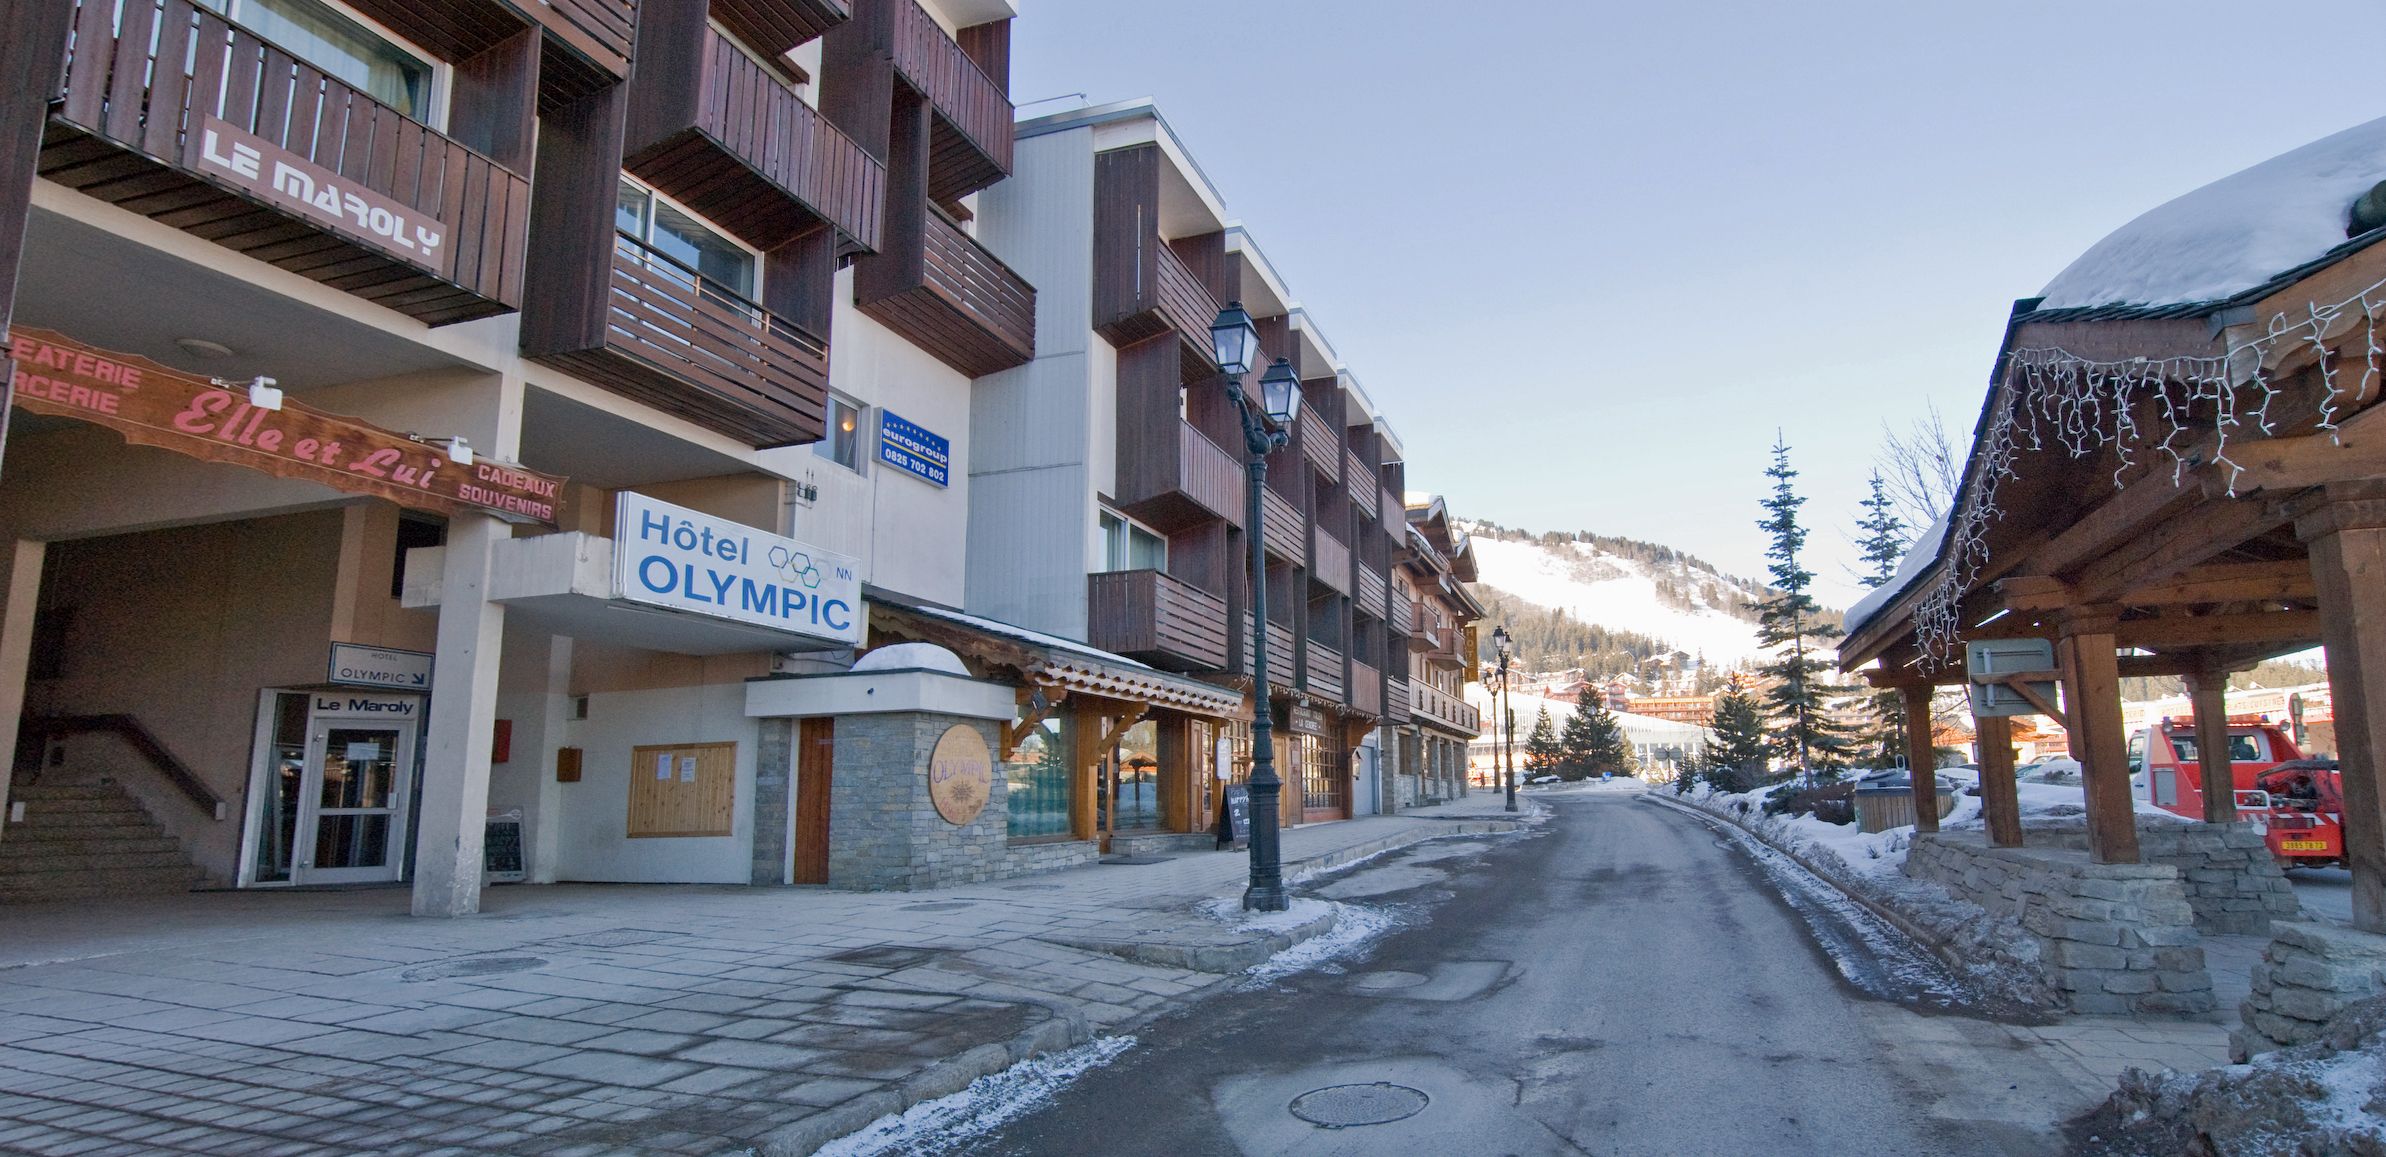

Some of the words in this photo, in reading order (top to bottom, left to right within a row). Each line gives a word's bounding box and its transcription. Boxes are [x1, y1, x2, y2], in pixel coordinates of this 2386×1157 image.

[203, 129, 261, 181] LE
[272, 160, 441, 256] MAROLY
[174, 390, 284, 452] Elle
[294, 437, 342, 465] et
[348, 448, 442, 489] Lui
[883, 427, 948, 464] eurogroup
[478, 464, 556, 498] CADEAUX
[885, 448, 908, 467] 0825
[910, 458, 926, 475] 702
[928, 467, 945, 482] 802
[458, 483, 553, 520] SOUVENIRS
[640, 508, 749, 567] Hôtel
[836, 566, 852, 582] NN
[638, 554, 852, 632] OLYMPIC
[371, 651, 399, 662] HOTEL
[341, 667, 406, 683] OLYMPIC
[316, 698, 341, 712] Le
[348, 698, 414, 716] Maroly
[933, 759, 989, 784] OLYMPIC
